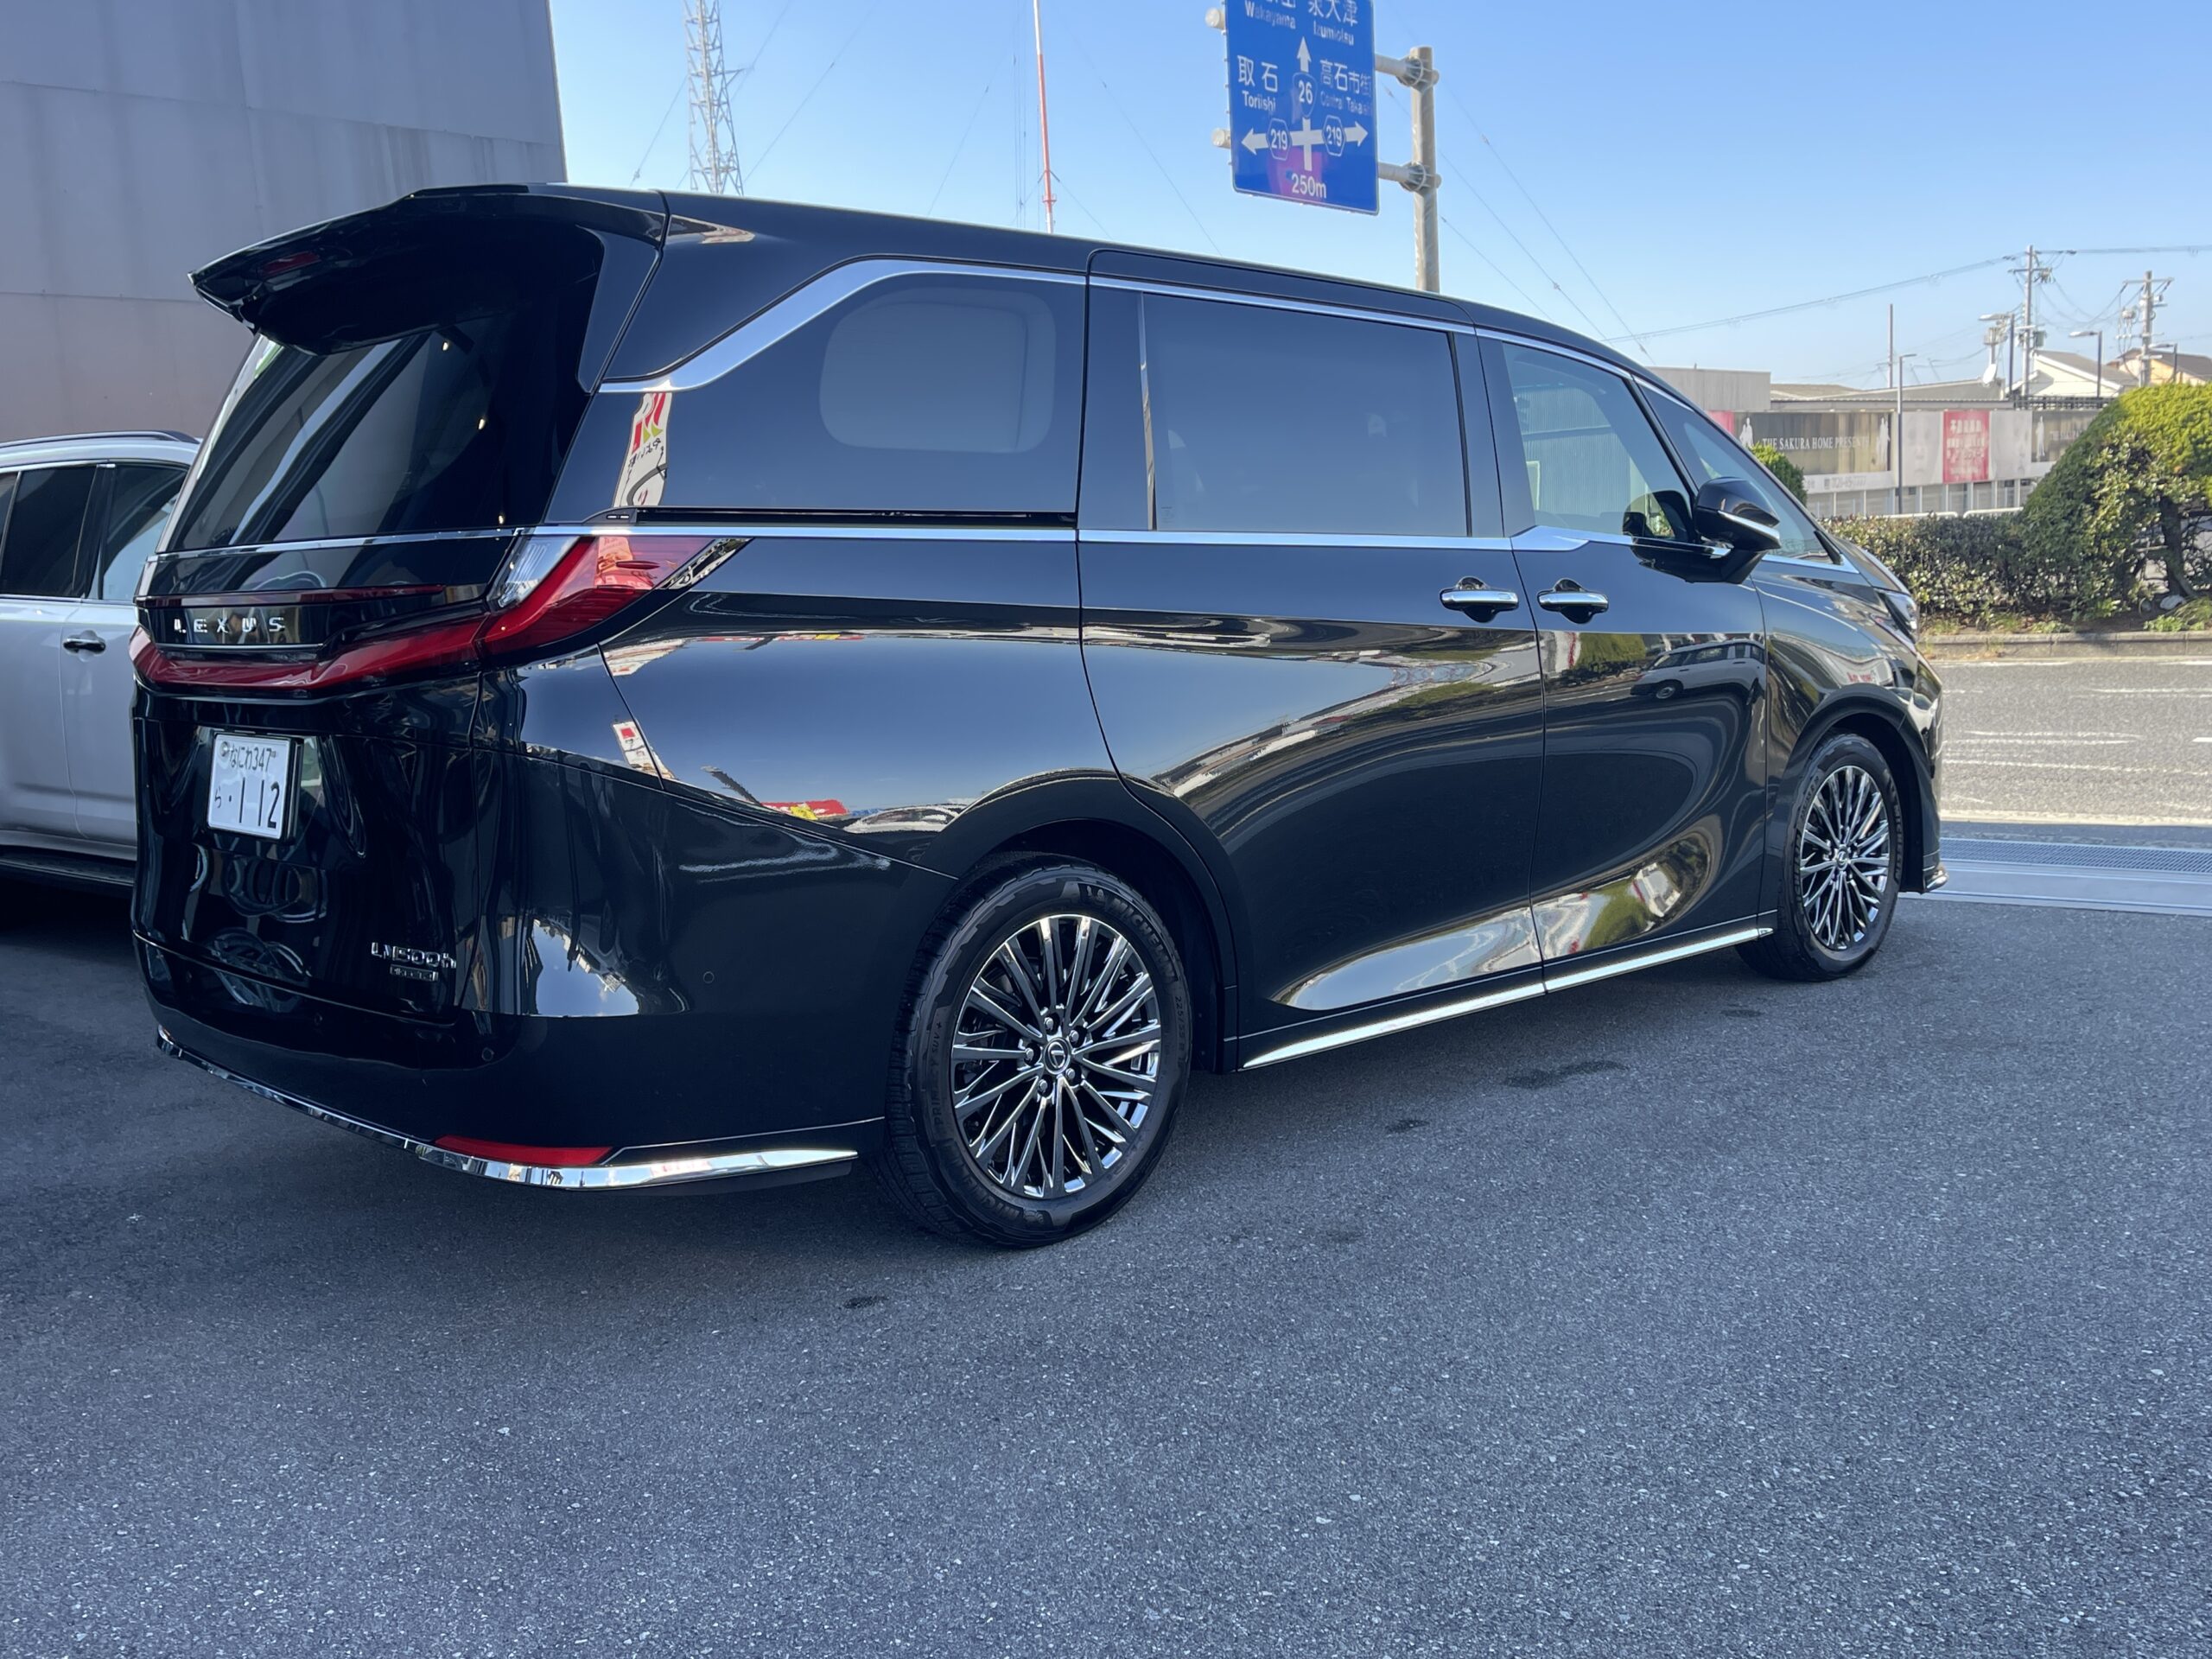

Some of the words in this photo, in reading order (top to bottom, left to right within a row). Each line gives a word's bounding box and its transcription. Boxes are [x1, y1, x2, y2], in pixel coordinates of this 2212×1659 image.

[1237, 54, 1279, 92] 取石
[1242, 90, 1276, 111] Toriishi
[1298, 79, 1313, 105] 26
[1270, 128, 1288, 150] 219
[1325, 124, 1343, 147] 219
[1291, 173, 1327, 199] 250m
[1779, 437, 1810, 450] SAKURA
[1812, 436, 1833, 449] HOME
[174, 617, 286, 633] LEXUS
[1109, 895, 1176, 978] MICHELIN
[930, 1059, 943, 1125] PRIMCY
